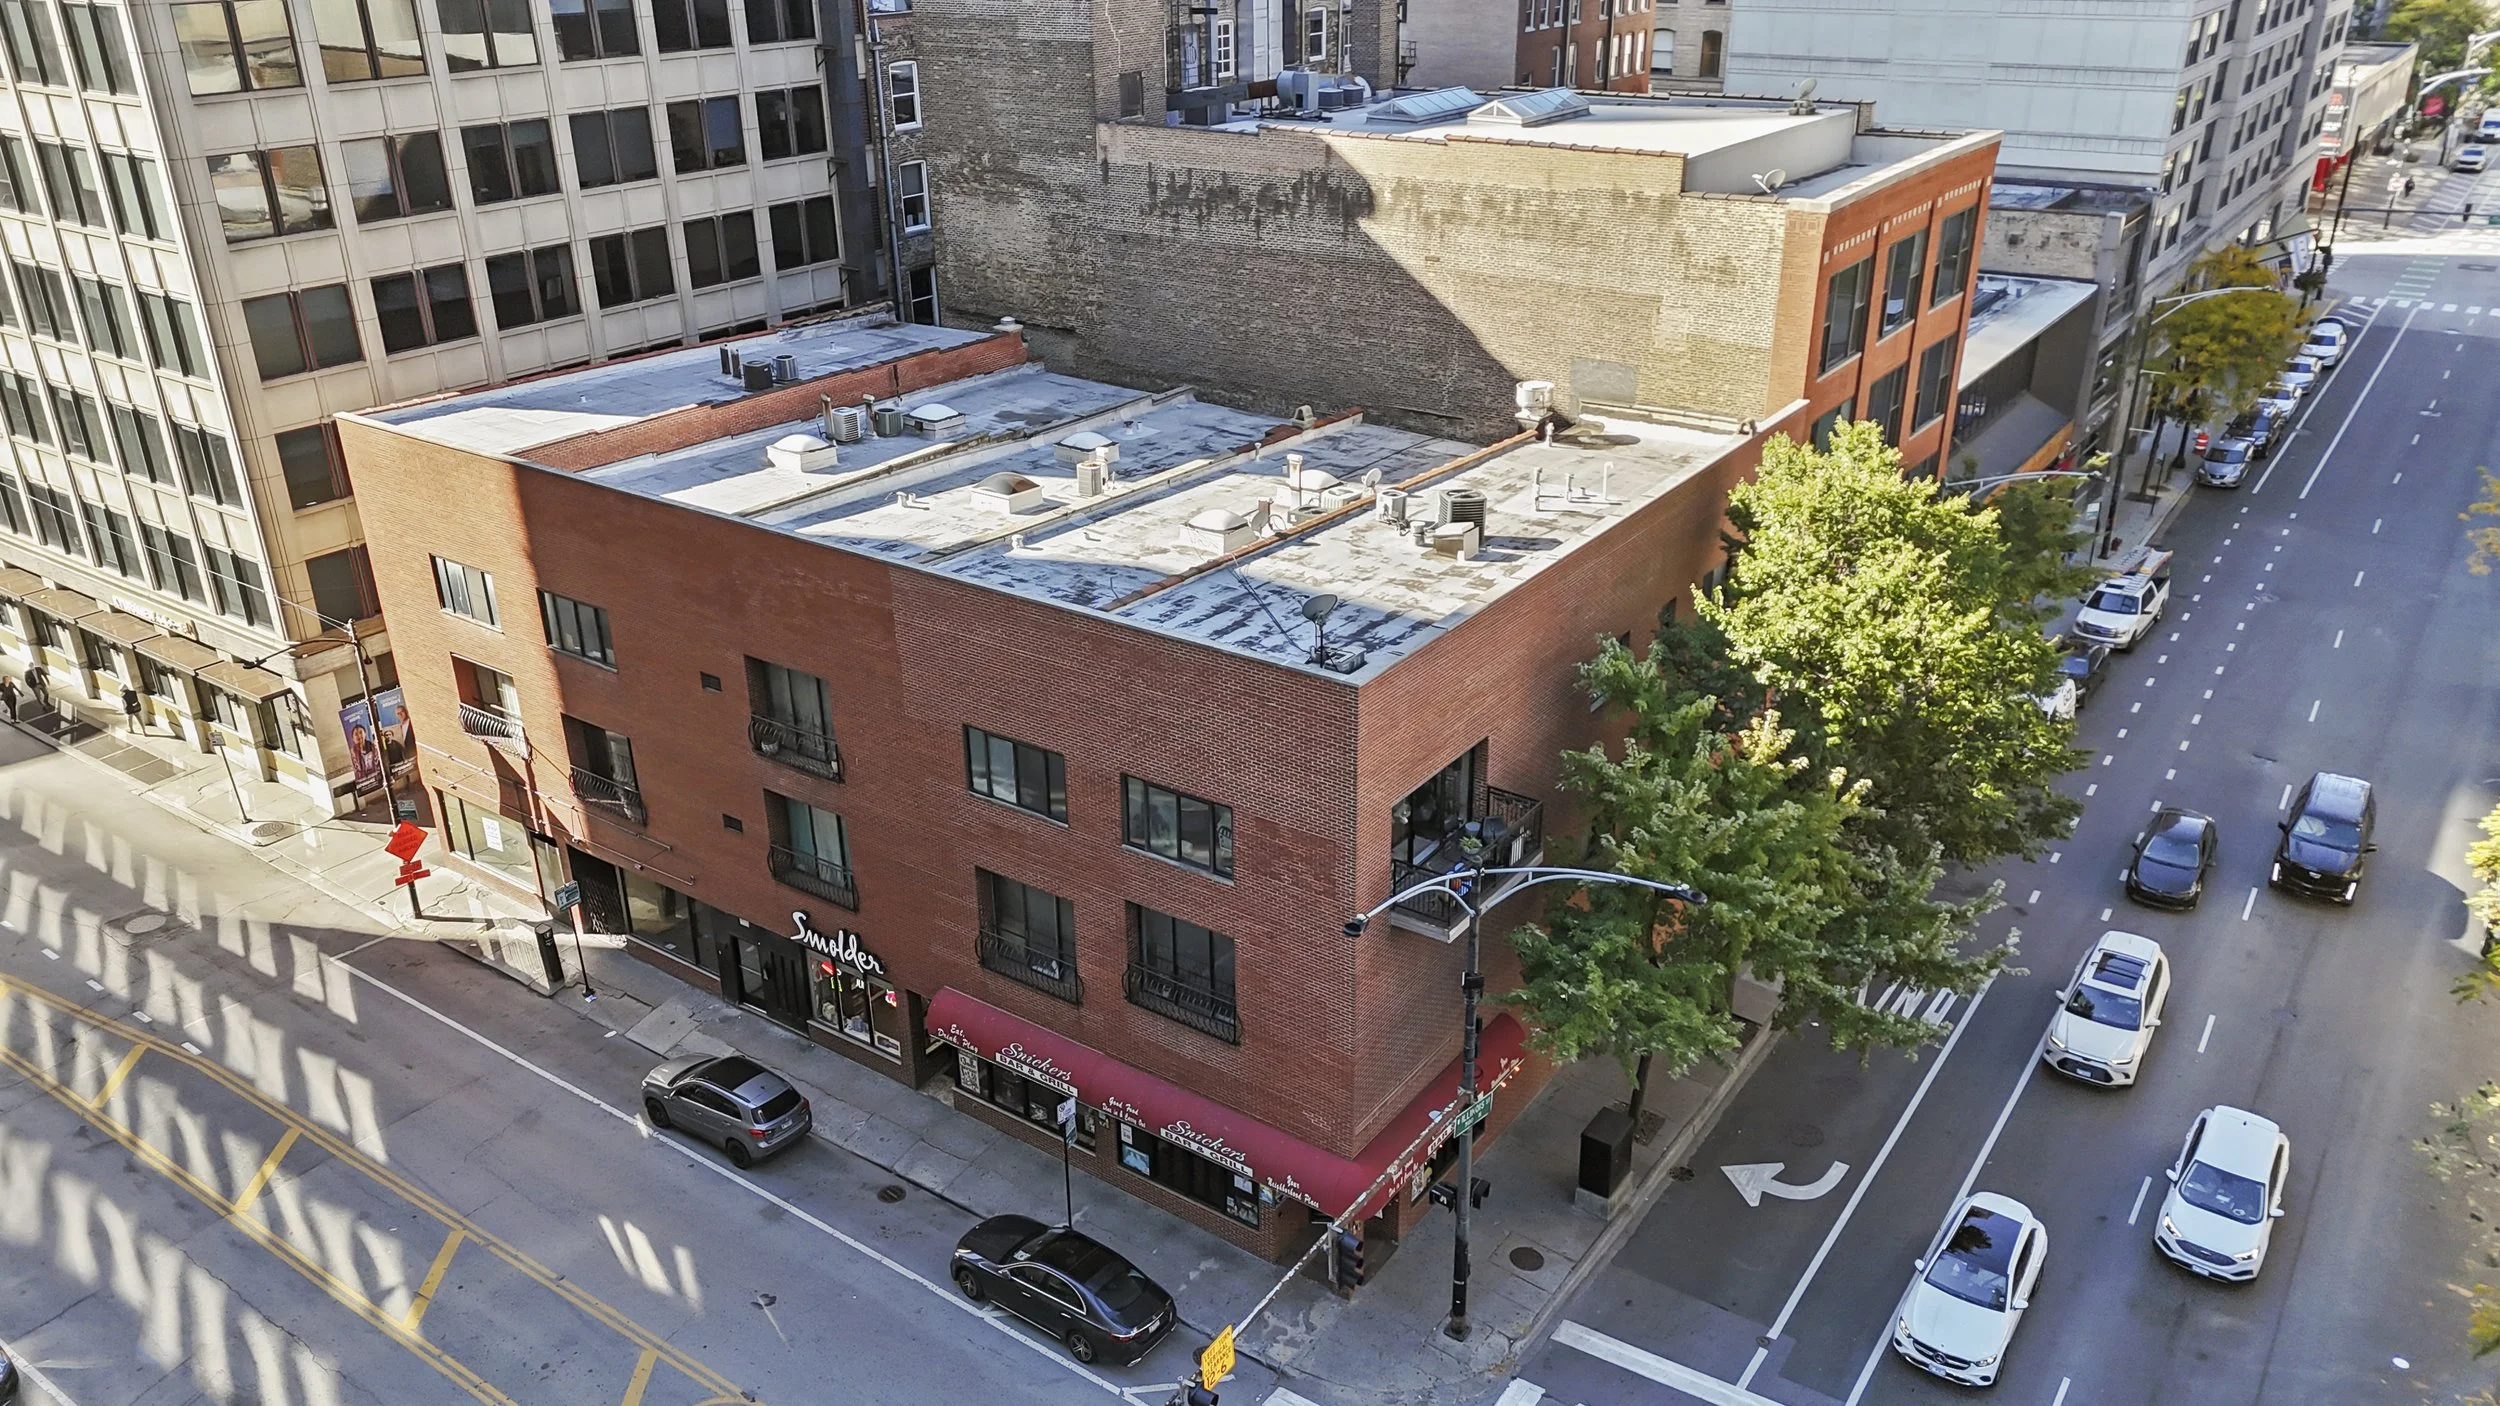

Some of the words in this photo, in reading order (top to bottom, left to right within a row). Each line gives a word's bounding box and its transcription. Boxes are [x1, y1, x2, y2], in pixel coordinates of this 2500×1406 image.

[790, 911, 884, 974] Smolder
[962, 1038, 979, 1054] Play
[1001, 1042, 1072, 1081] Snickers
[1000, 1055, 1024, 1072] BAR
[1027, 1068, 1036, 1076] &
[1039, 1073, 1075, 1095] GRILL
[1101, 1102, 1112, 1113] Dine
[1124, 1113, 1137, 1125] Carry
[1138, 1119, 1146, 1128] Out
[1108, 1096, 1123, 1109] Good
[1125, 1103, 1139, 1116] Food
[1164, 1131, 1192, 1148] BAR
[1196, 1145, 1205, 1154] &
[1209, 1151, 1249, 1175] GRILL
[1167, 1120, 1247, 1162] Snickers
[1266, 1176, 1302, 1200] Neighborhood
[1304, 1193, 1320, 1208] Place
[1286, 1174, 1300, 1189] Your
